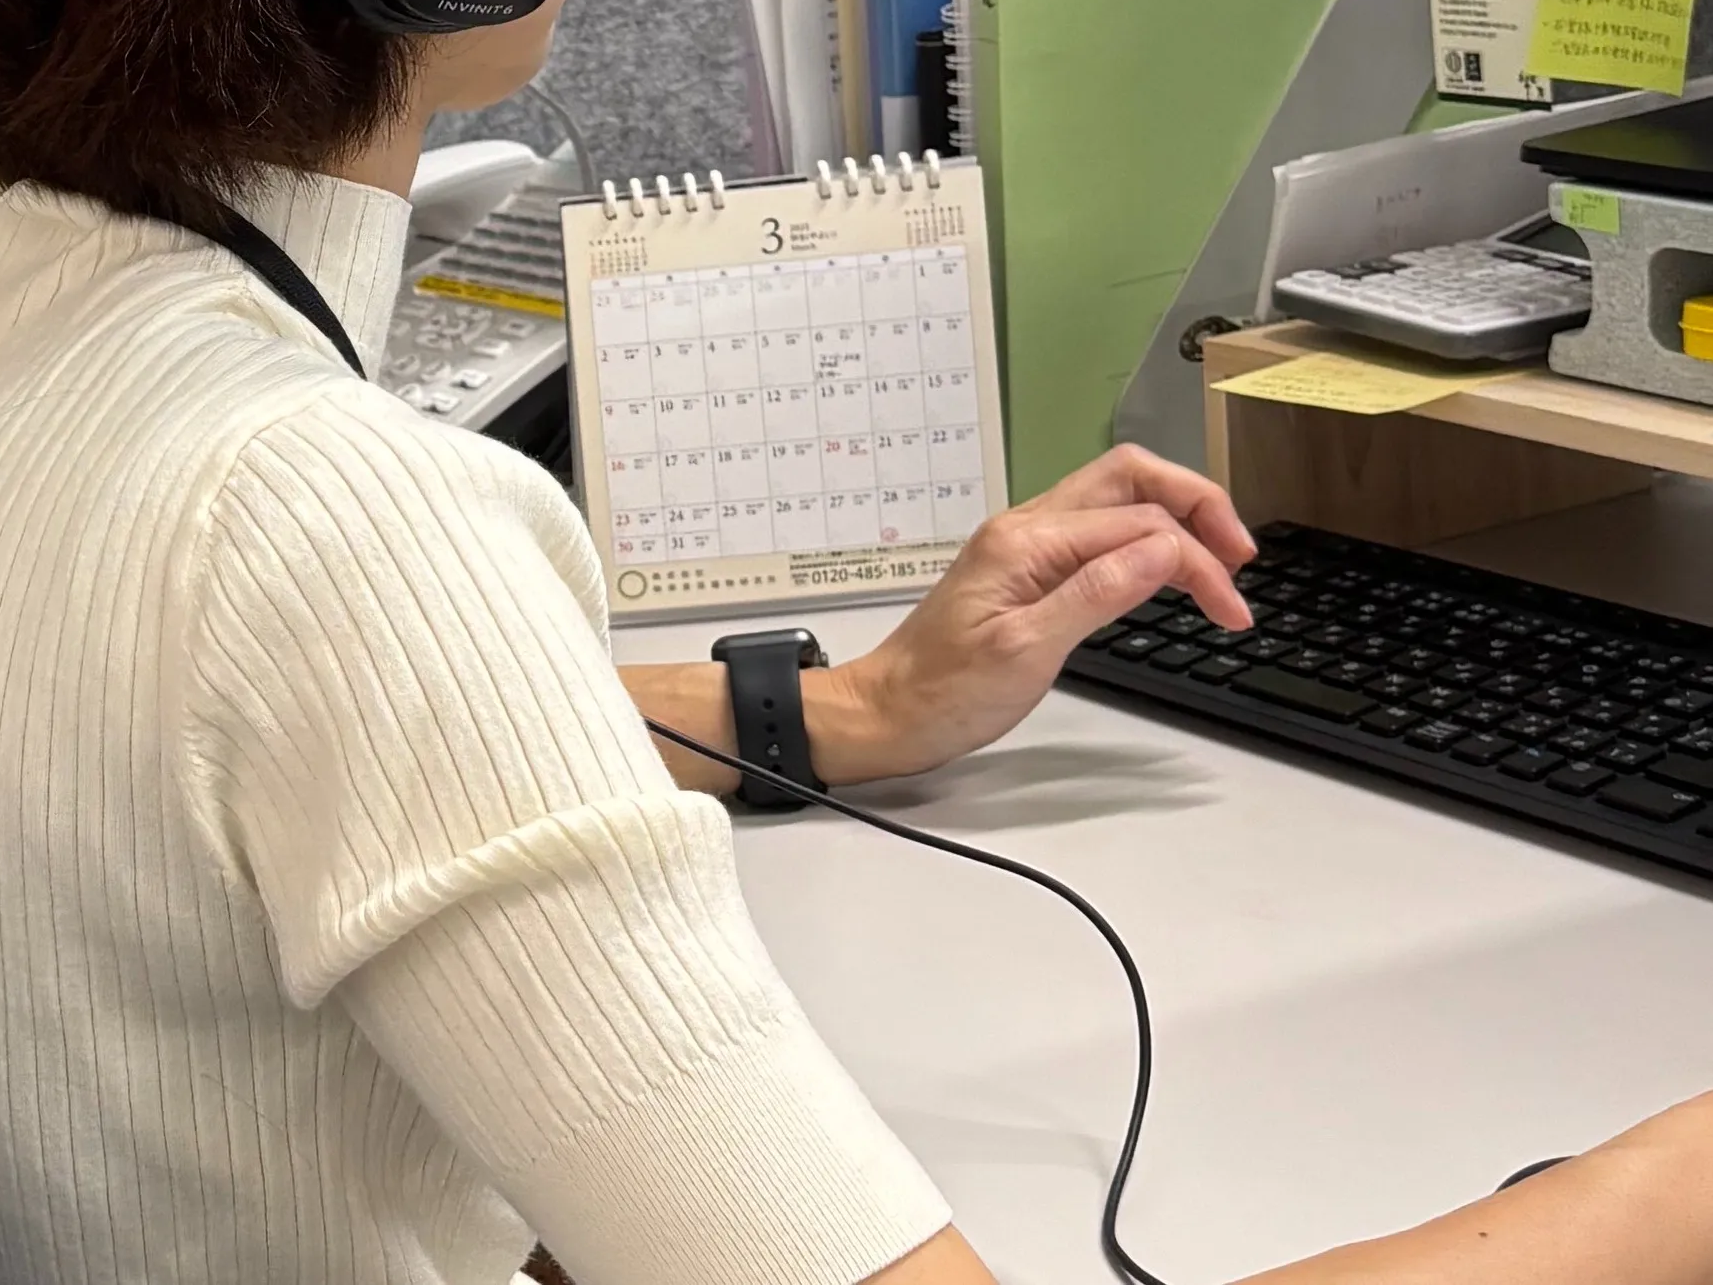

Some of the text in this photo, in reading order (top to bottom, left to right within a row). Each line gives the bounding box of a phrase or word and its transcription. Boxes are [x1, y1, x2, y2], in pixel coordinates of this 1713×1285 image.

[761, 217, 784, 255] 3
[707, 341, 716, 353] 4
[815, 332, 824, 343] 6
[661, 399, 674, 413] 10
[714, 395, 726, 407] 11
[767, 390, 781, 402] 12
[821, 385, 835, 398] 13
[875, 381, 888, 394] 14
[928, 375, 943, 388] 15
[665, 455, 678, 467] 17
[718, 451, 732, 463] 18
[772, 446, 786, 458] 19
[825, 440, 841, 453] 20
[879, 435, 892, 448] 21
[669, 509, 685, 522] 24
[723, 505, 737, 517] 25
[776, 500, 792, 513] 26
[830, 495, 844, 508] 27
[883, 491, 899, 503] 28
[672, 537, 685, 549] 31
[811, 562, 916, 584] 0120-485-185
